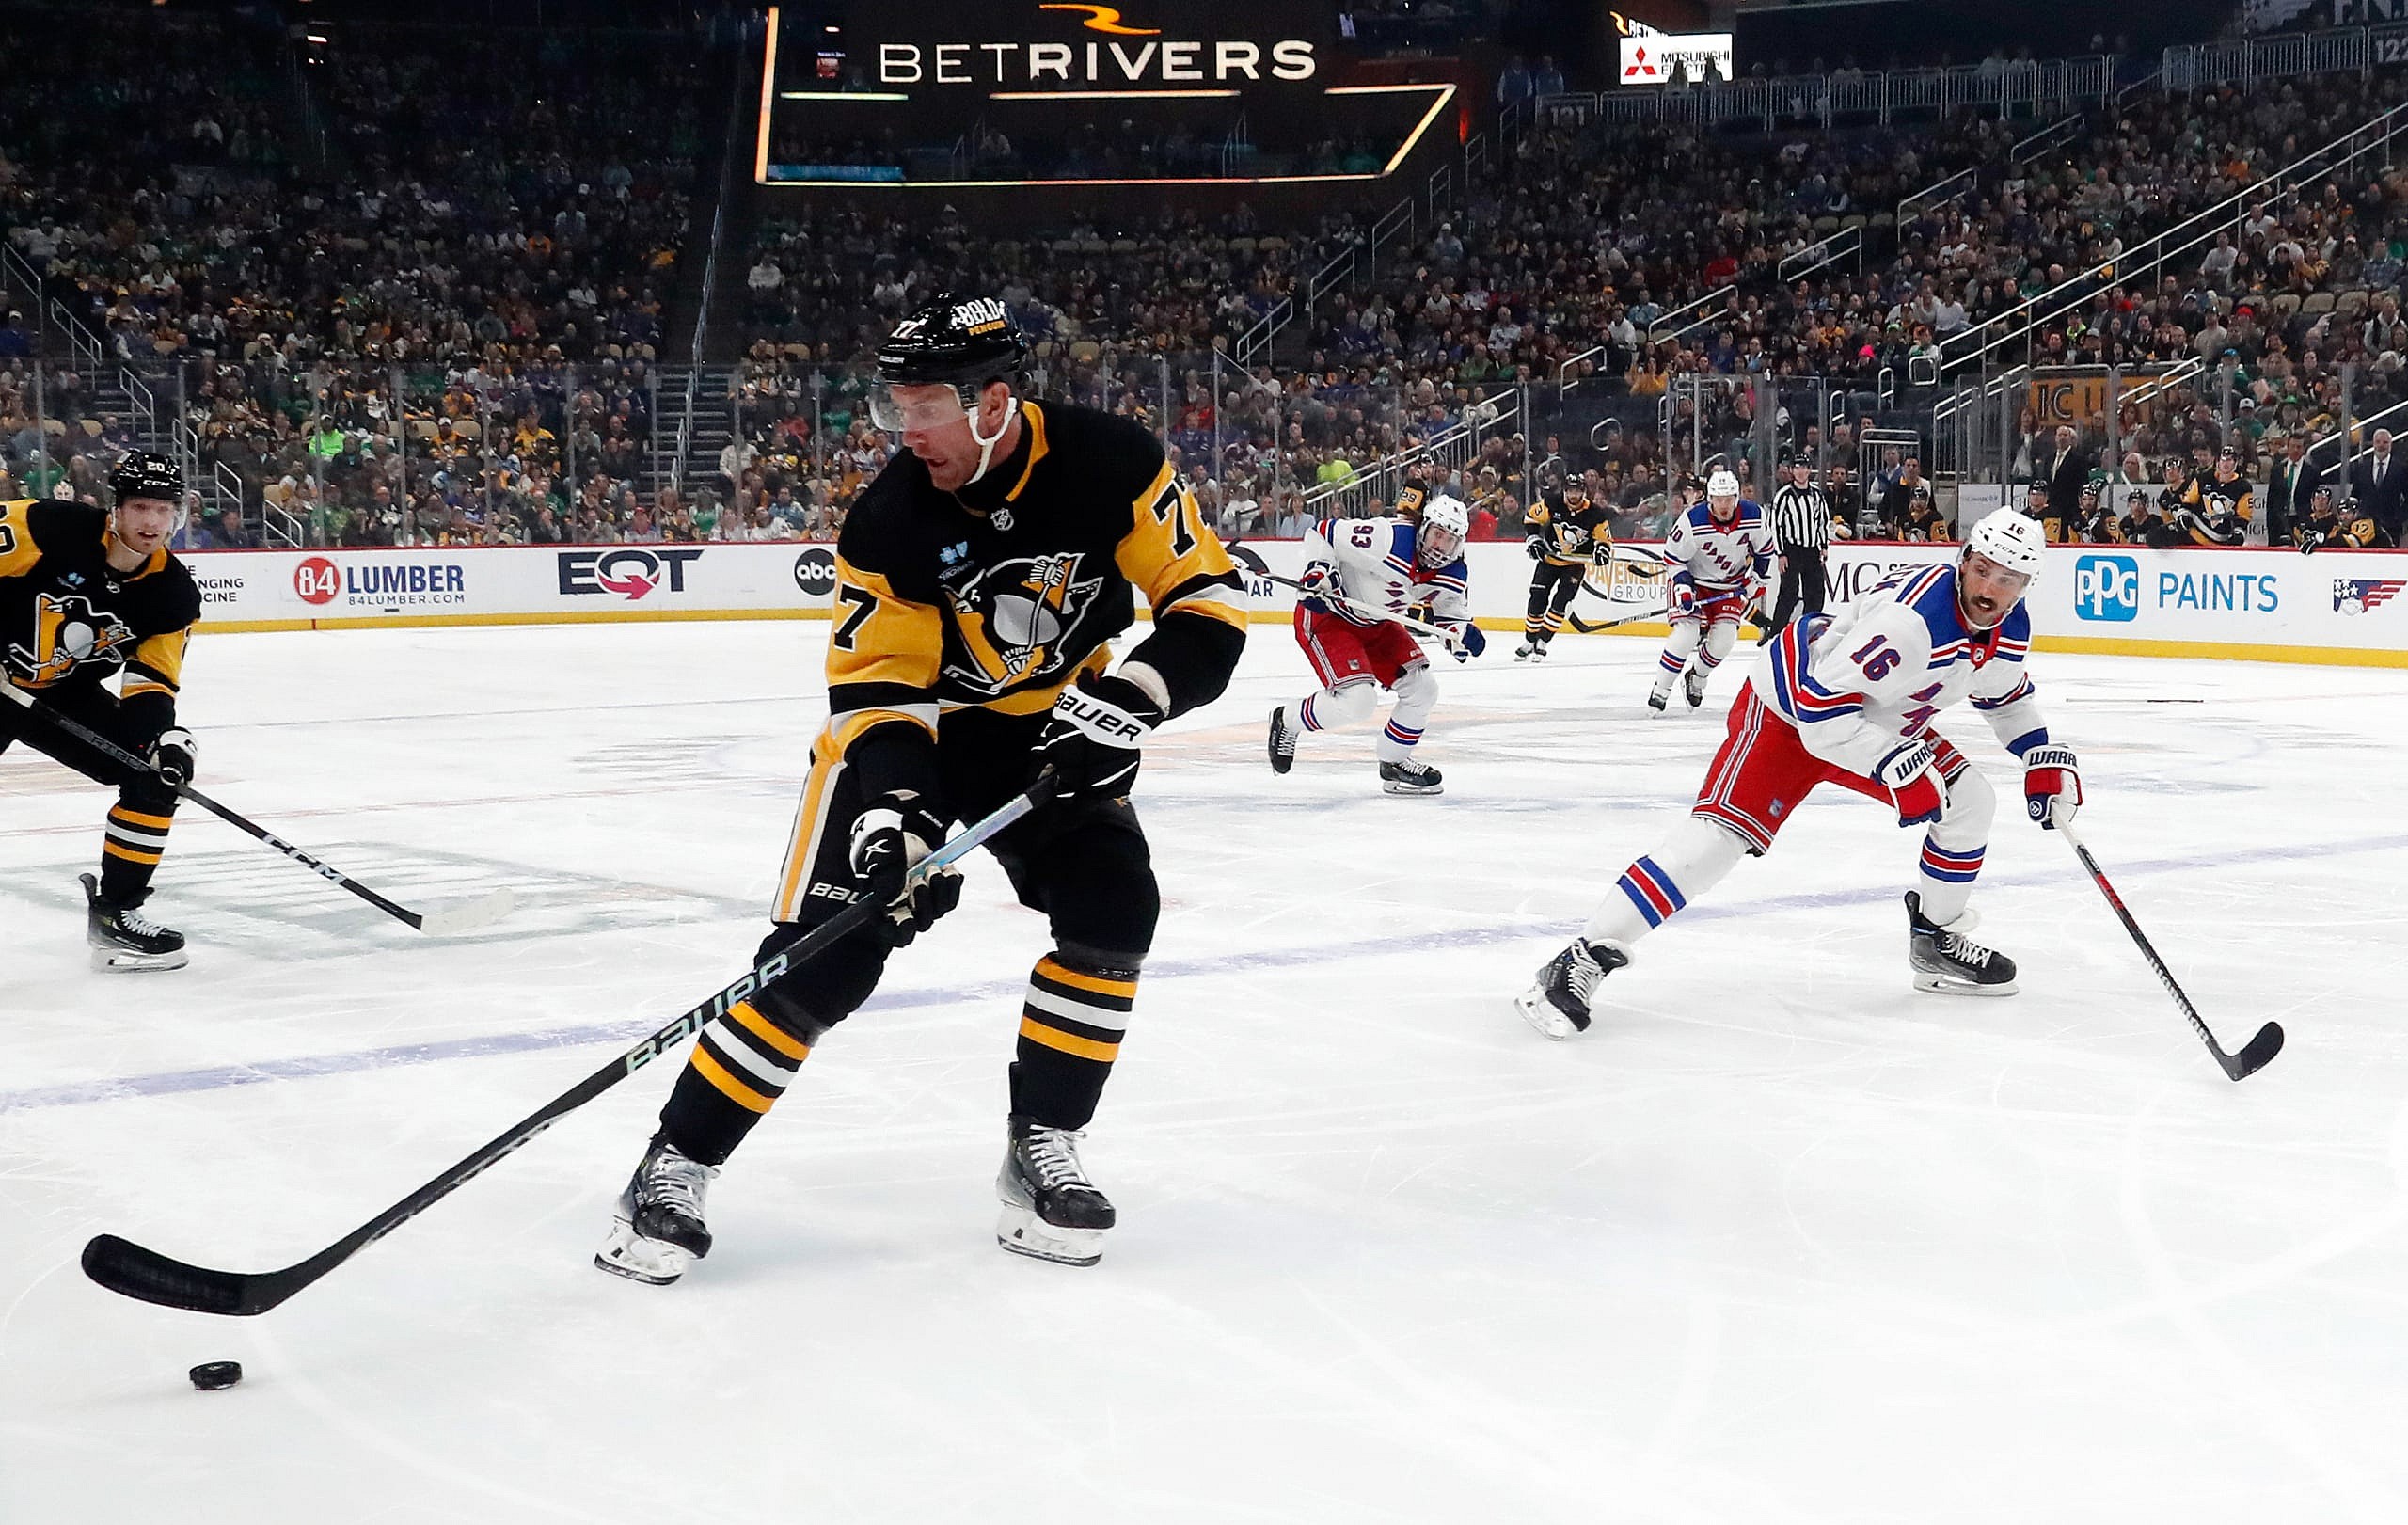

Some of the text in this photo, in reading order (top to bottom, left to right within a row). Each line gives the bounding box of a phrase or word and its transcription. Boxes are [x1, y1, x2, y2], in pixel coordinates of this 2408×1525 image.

[879, 40, 1316, 83] BETRIVERS
[1661, 50, 1730, 63] MITSUBISHI
[956, 297, 1001, 326] BOLD
[146, 461, 166, 472] 20
[1151, 473, 1209, 560] 7
[1351, 525, 1374, 549] 93
[2007, 522, 2024, 536] 16
[1993, 543, 2017, 555] CCM
[297, 564, 464, 596] 84 LUMBER
[558, 548, 705, 600] EQT
[796, 562, 837, 580] abc
[198, 579, 244, 589] NGING
[1614, 585, 1666, 599] GROUP
[2077, 560, 2279, 617] PPG PAINTS
[203, 592, 237, 603] CINE
[348, 594, 465, 606] 84LUMBER.COM
[1851, 633, 1902, 682] 16
[1054, 691, 1142, 743] BAUER
[2029, 750, 2078, 768] WARR
[809, 882, 860, 905] BAU
[625, 953, 789, 1075] BAUER
